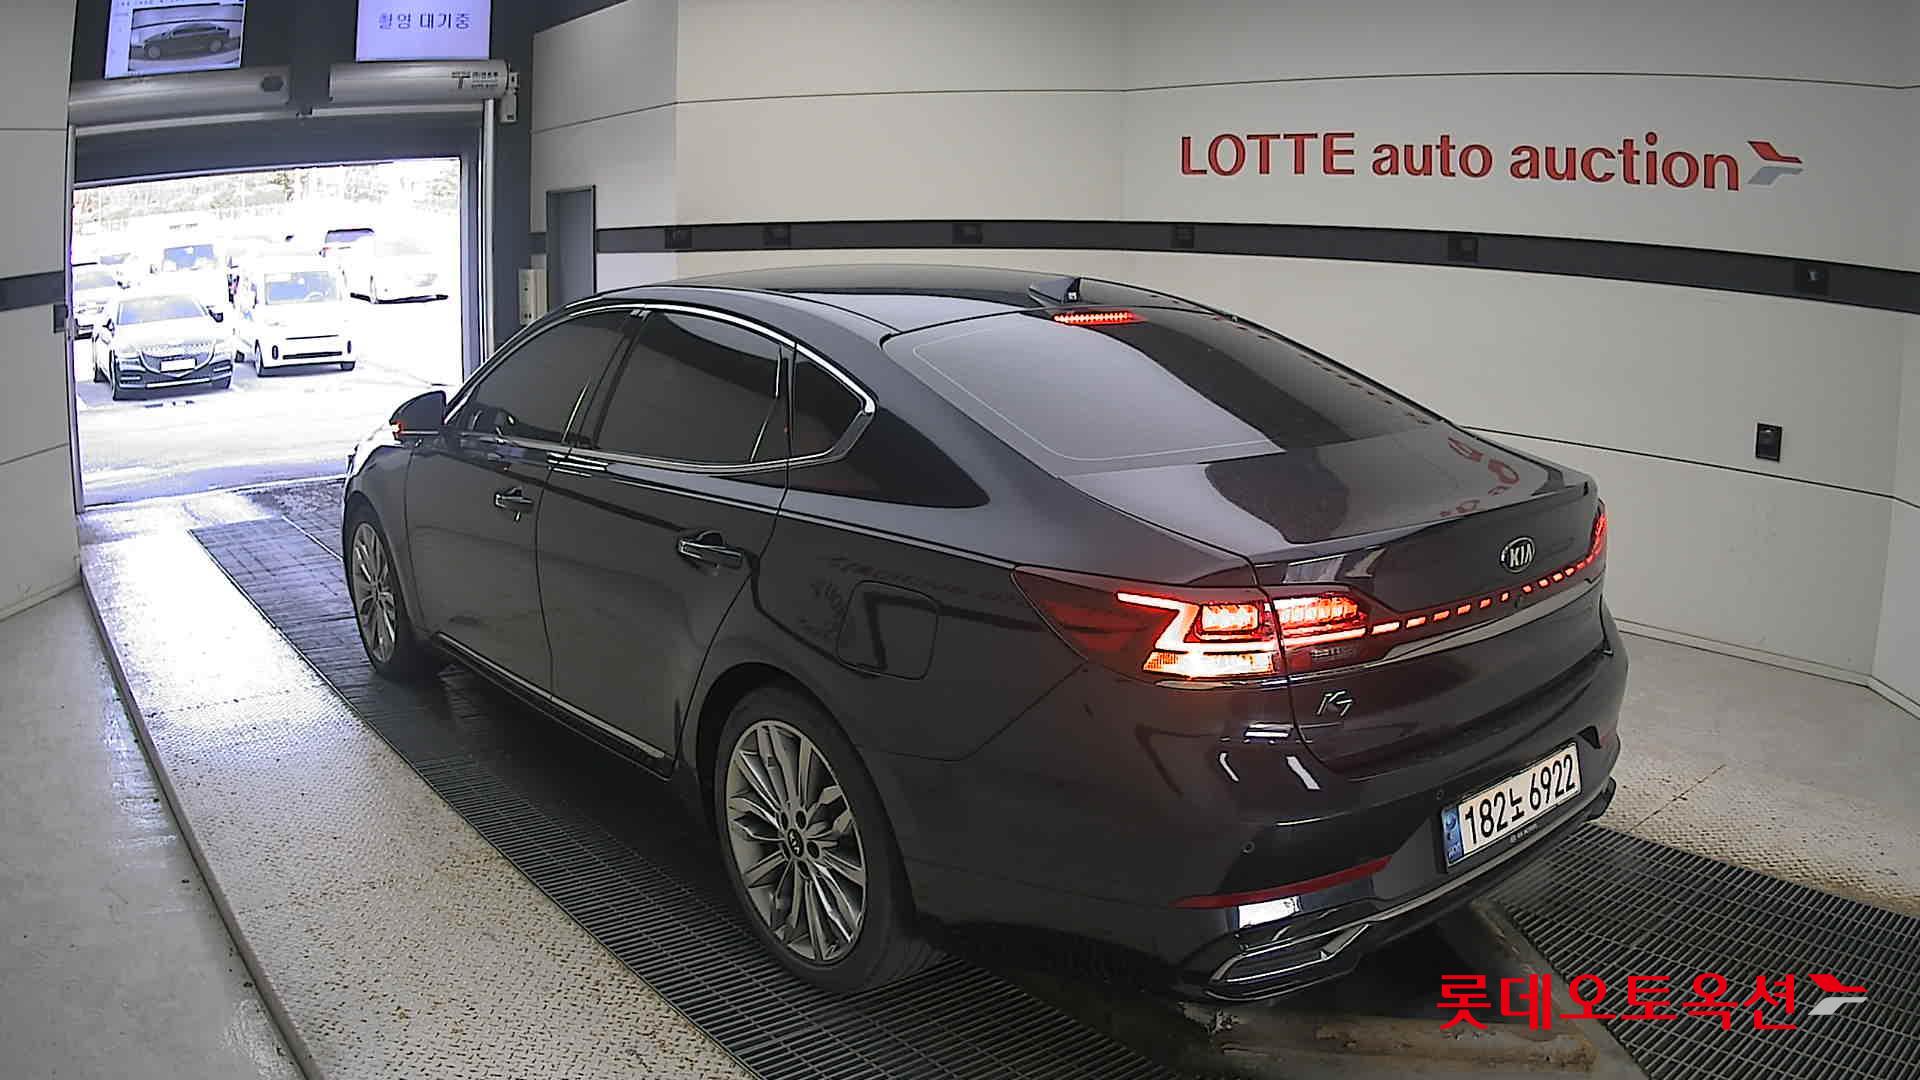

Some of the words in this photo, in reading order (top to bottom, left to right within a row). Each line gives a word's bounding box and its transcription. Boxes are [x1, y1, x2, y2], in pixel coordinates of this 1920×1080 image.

[420, 13, 470, 30] 대기중
[1180, 132, 1356, 177] LOTTE
[1372, 134, 1494, 178] auto
[1510, 131, 1741, 192] auction
[1510, 543, 1533, 568] KIA
[1464, 787, 1526, 846] 182노
[1528, 753, 1577, 811] 6922
